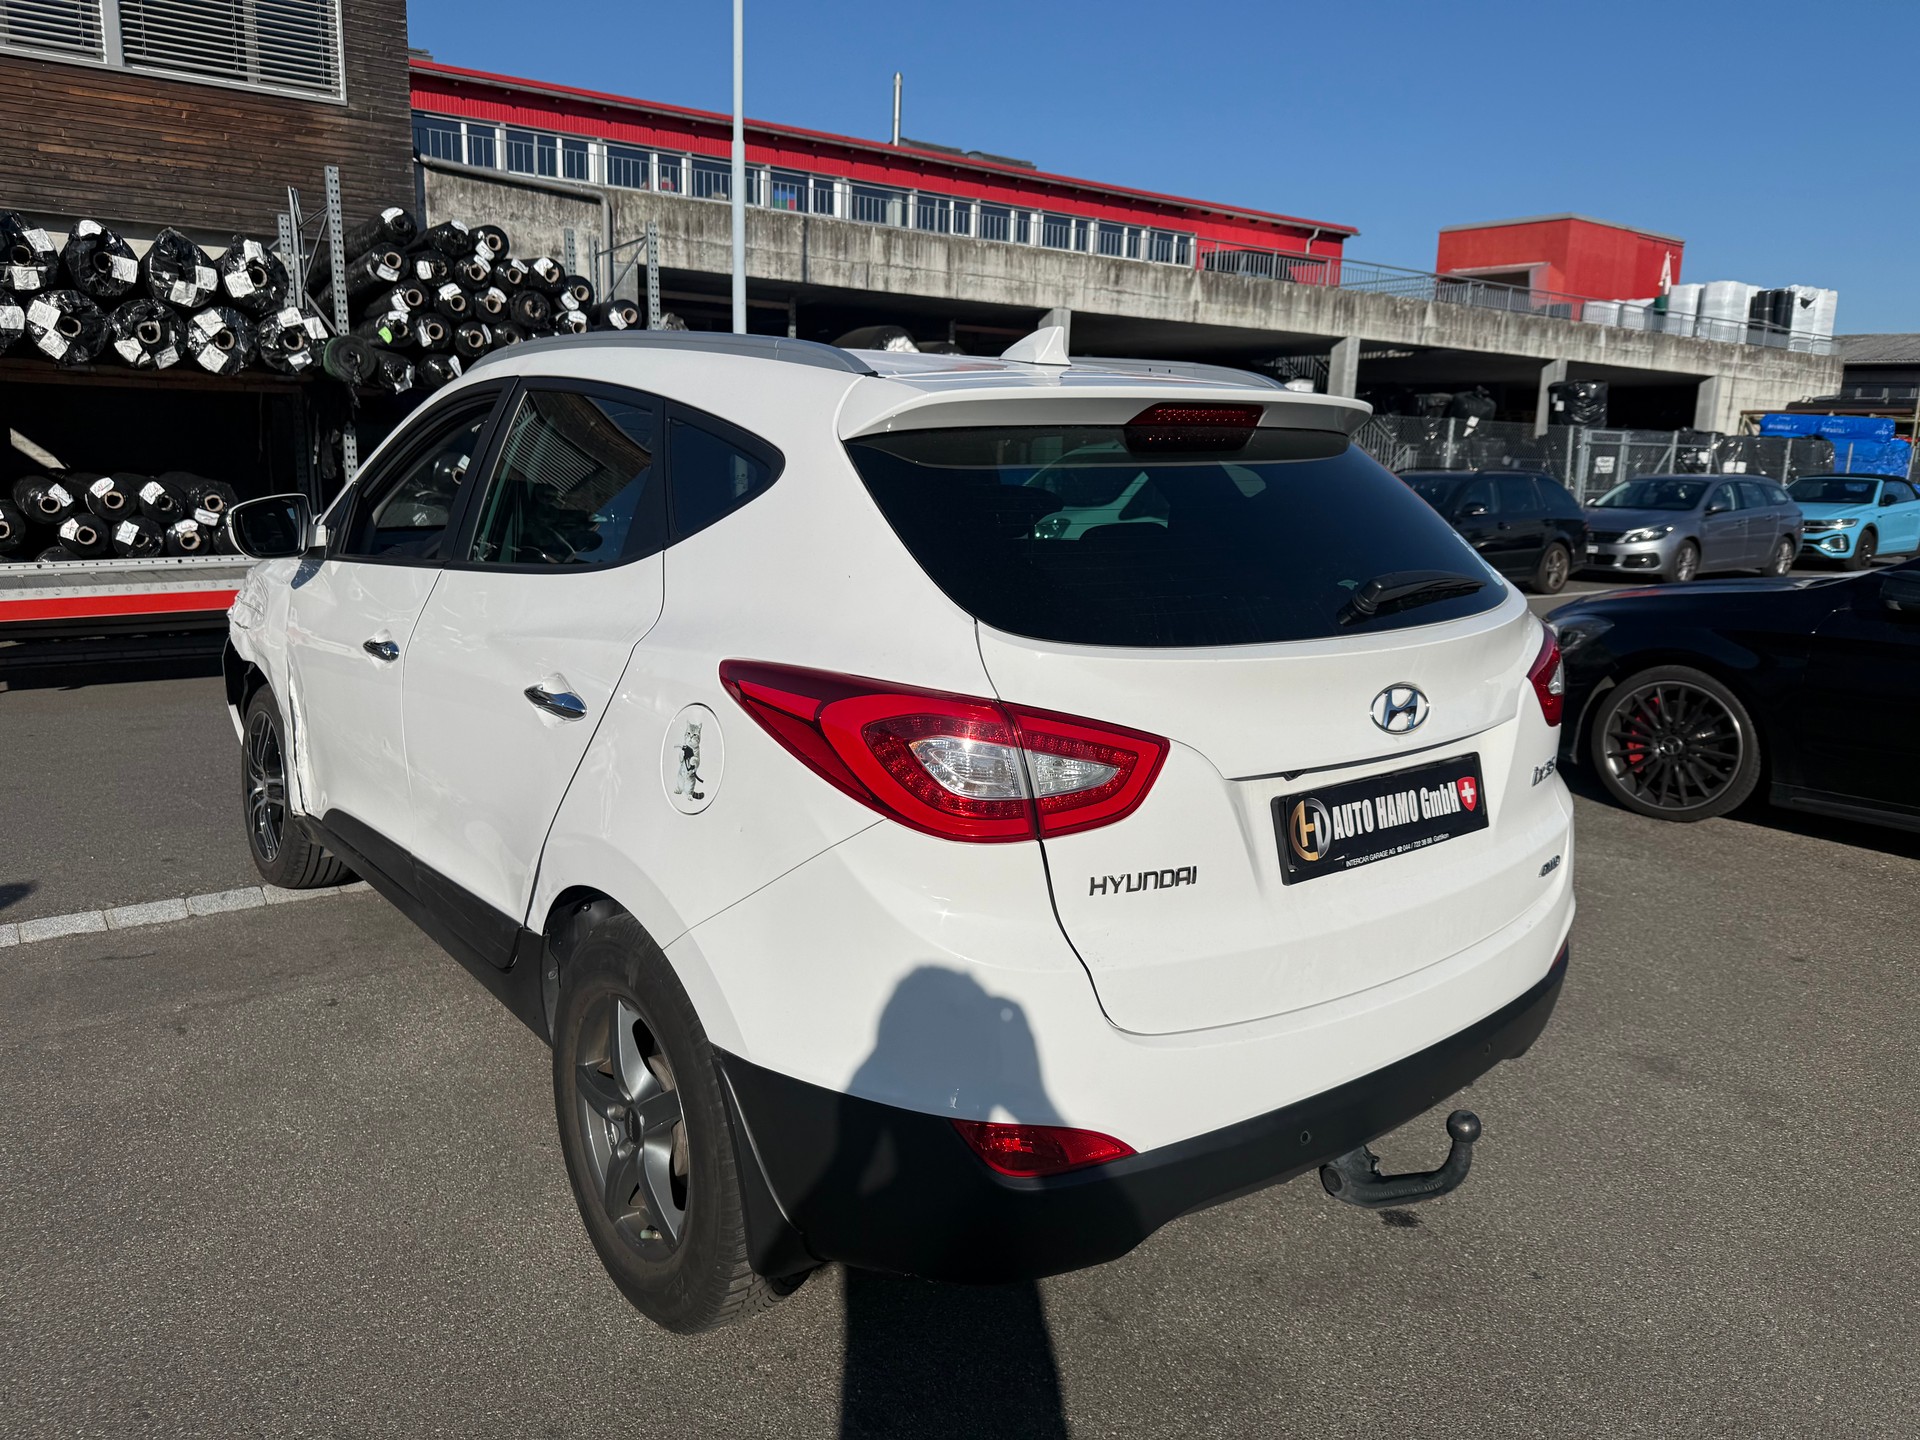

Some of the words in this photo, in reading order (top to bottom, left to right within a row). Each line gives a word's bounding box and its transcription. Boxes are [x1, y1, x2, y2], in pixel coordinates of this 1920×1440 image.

[1331, 798, 1375, 841] AUTO
[1375, 788, 1420, 831] HAMO
[1419, 780, 1462, 820] GmbH
[1370, 850, 1389, 861] GARAGE
[1088, 865, 1198, 897] HYUNDAI
